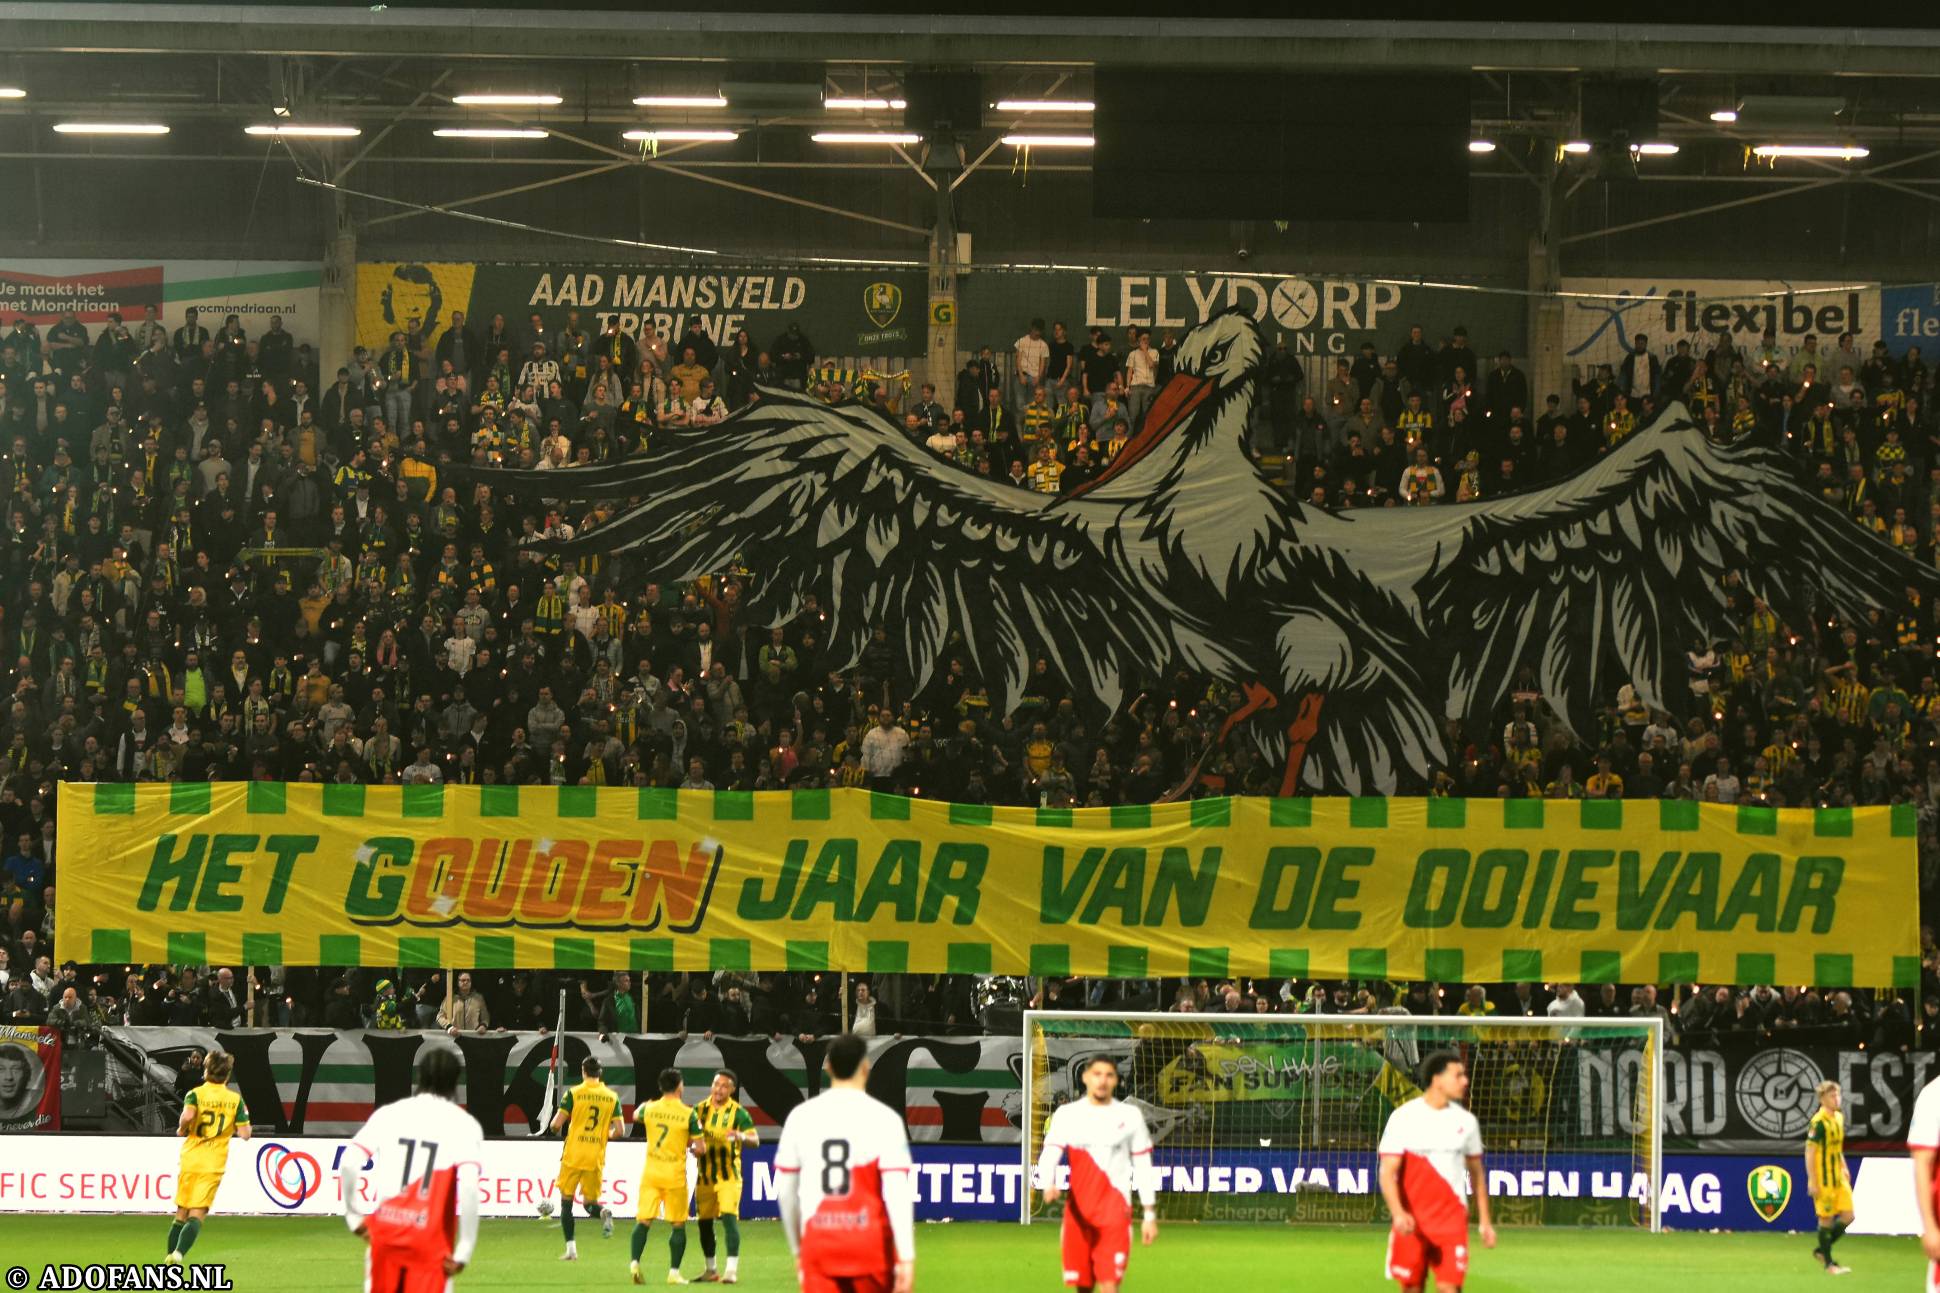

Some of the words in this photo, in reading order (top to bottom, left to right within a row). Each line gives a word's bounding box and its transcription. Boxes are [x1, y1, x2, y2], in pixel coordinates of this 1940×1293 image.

[0, 282, 16, 295] Je
[20, 282, 73, 295] maakt
[77, 282, 105, 296] het
[529, 273, 604, 306] AAD
[612, 274, 806, 310] MANSVELD
[1086, 275, 1402, 330] LELYDORP
[0, 301, 28, 311] met
[31, 299, 119, 312] Mondriaan
[934, 304, 952, 323] G
[1662, 290, 1862, 335] flexibel
[137, 833, 319, 913] HET
[344, 836, 724, 933] GOUDEN
[736, 838, 990, 926] JAAR
[1039, 846, 1223, 928] VAN
[1248, 846, 1376, 930] DE
[1402, 847, 1846, 935] OOIEVAAR
[1578, 1049, 1727, 1137] NORD
[196, 1109, 225, 1138] 21
[585, 1105, 600, 1132] 3
[656, 1122, 670, 1149] 7
[821, 1138, 850, 1196] 8
[60, 1174, 173, 1199] SERVIC
[479, 1178, 628, 1206] SERVES
